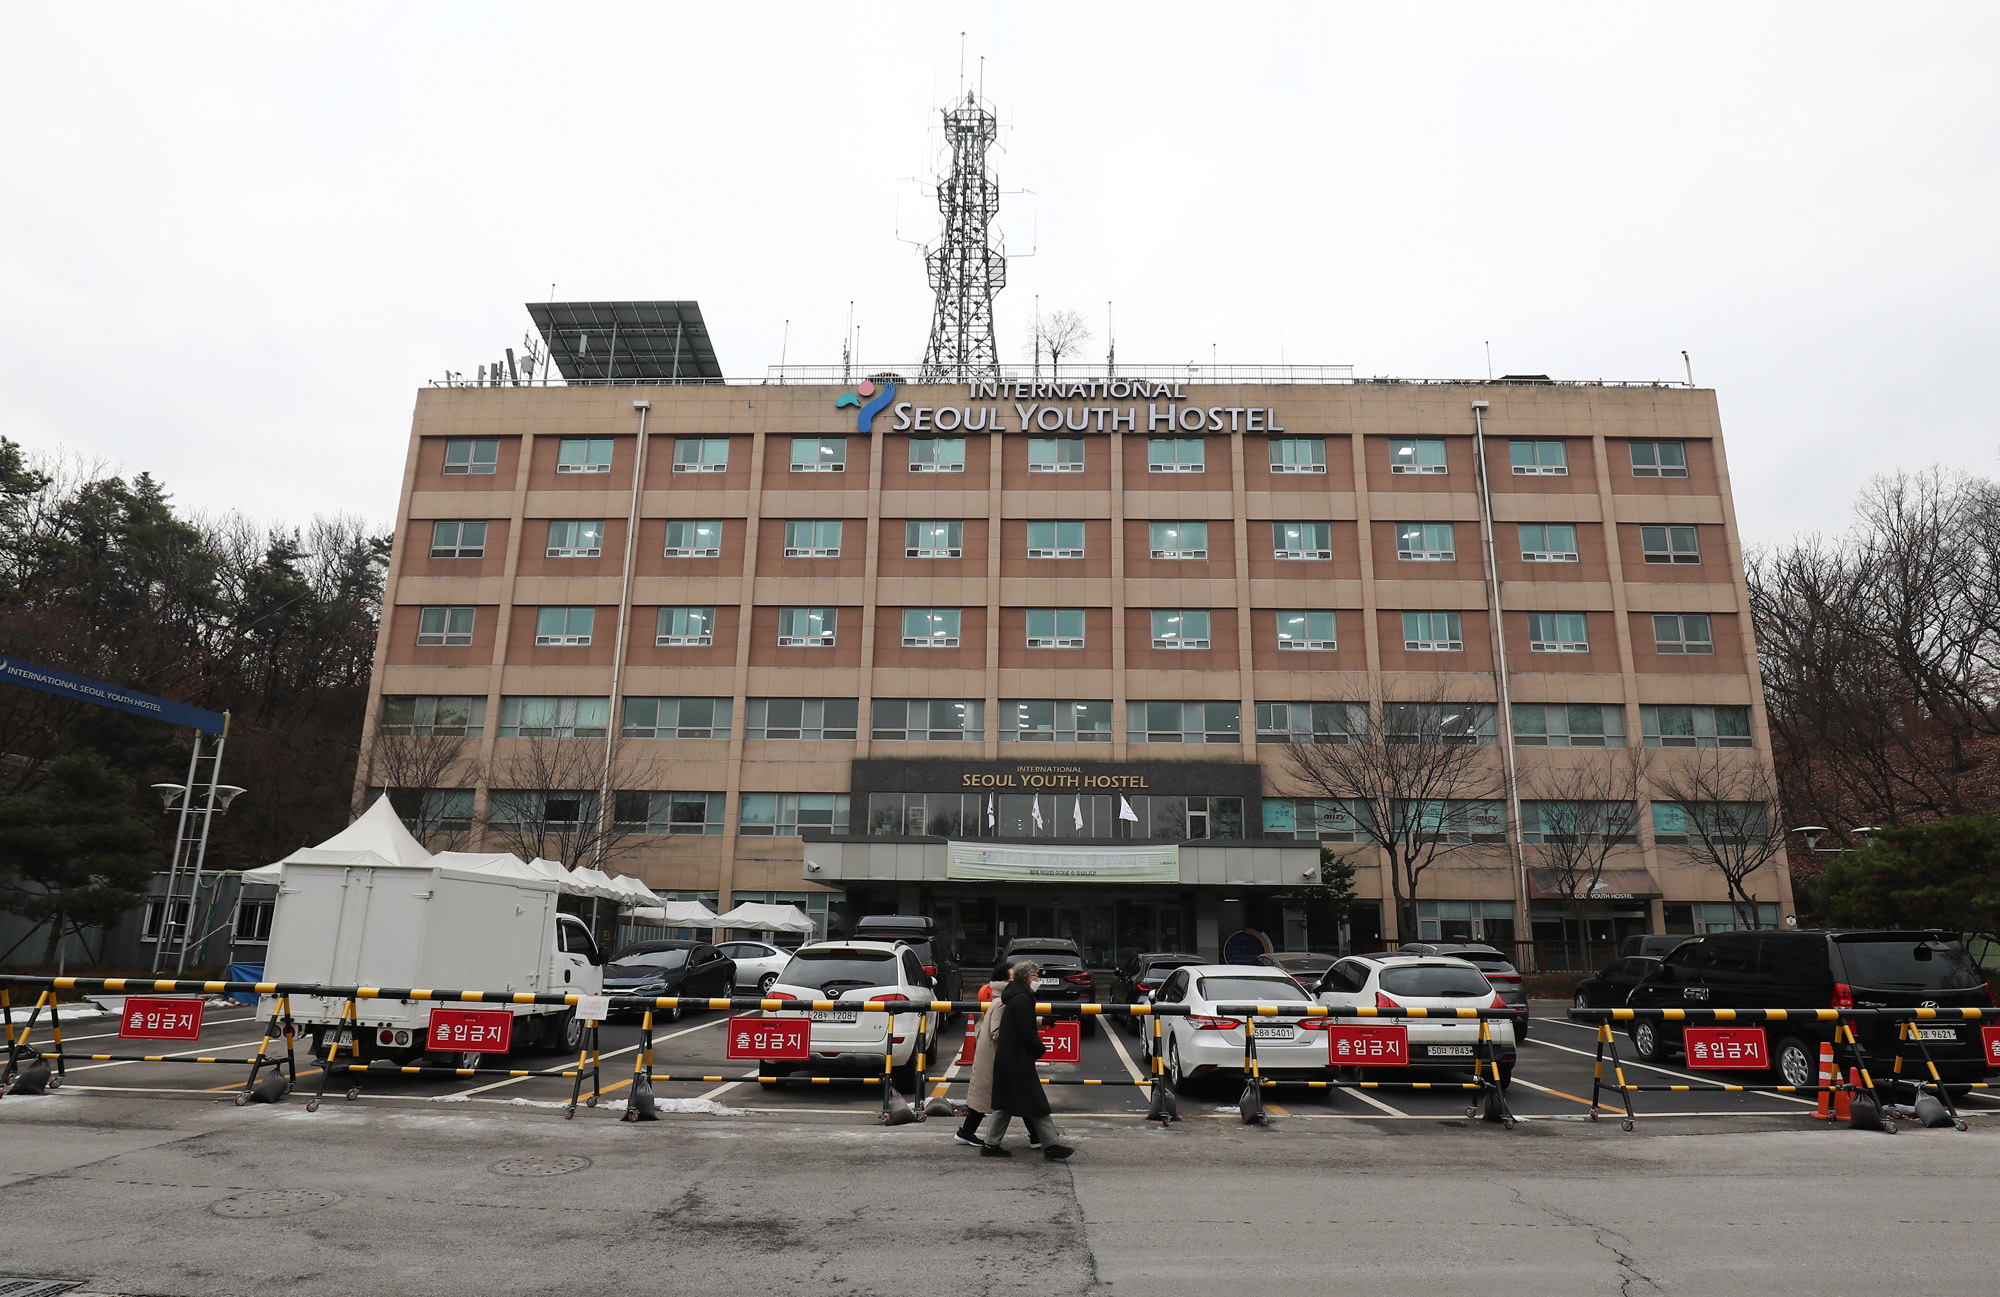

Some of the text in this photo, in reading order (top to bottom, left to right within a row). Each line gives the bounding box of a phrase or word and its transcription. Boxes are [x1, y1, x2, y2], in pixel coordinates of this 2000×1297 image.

[970, 381, 1187, 399] INTERNATIONAL
[892, 402, 1284, 432] SEOUL YOUTH HOSTEL
[7, 666, 162, 712] INTERNATIONAL SEOUL YOUTH HOSTEL
[962, 774, 1149, 788] SEOUL YOUTH HOSTEL
[130, 1012, 193, 1030] 출입금지
[832, 1011, 853, 1020] 1208
[436, 1023, 502, 1043] 출입금지
[736, 1032, 801, 1050] 출입금지
[1271, 1029, 1290, 1037] 5401
[1931, 1031, 1952, 1039] 9621
[1042, 1036, 1071, 1053] 금지
[1337, 1039, 1399, 1056] 출입금지
[1449, 1047, 1469, 1055] 7843
[1694, 1042, 1759, 1059] 출입금지
